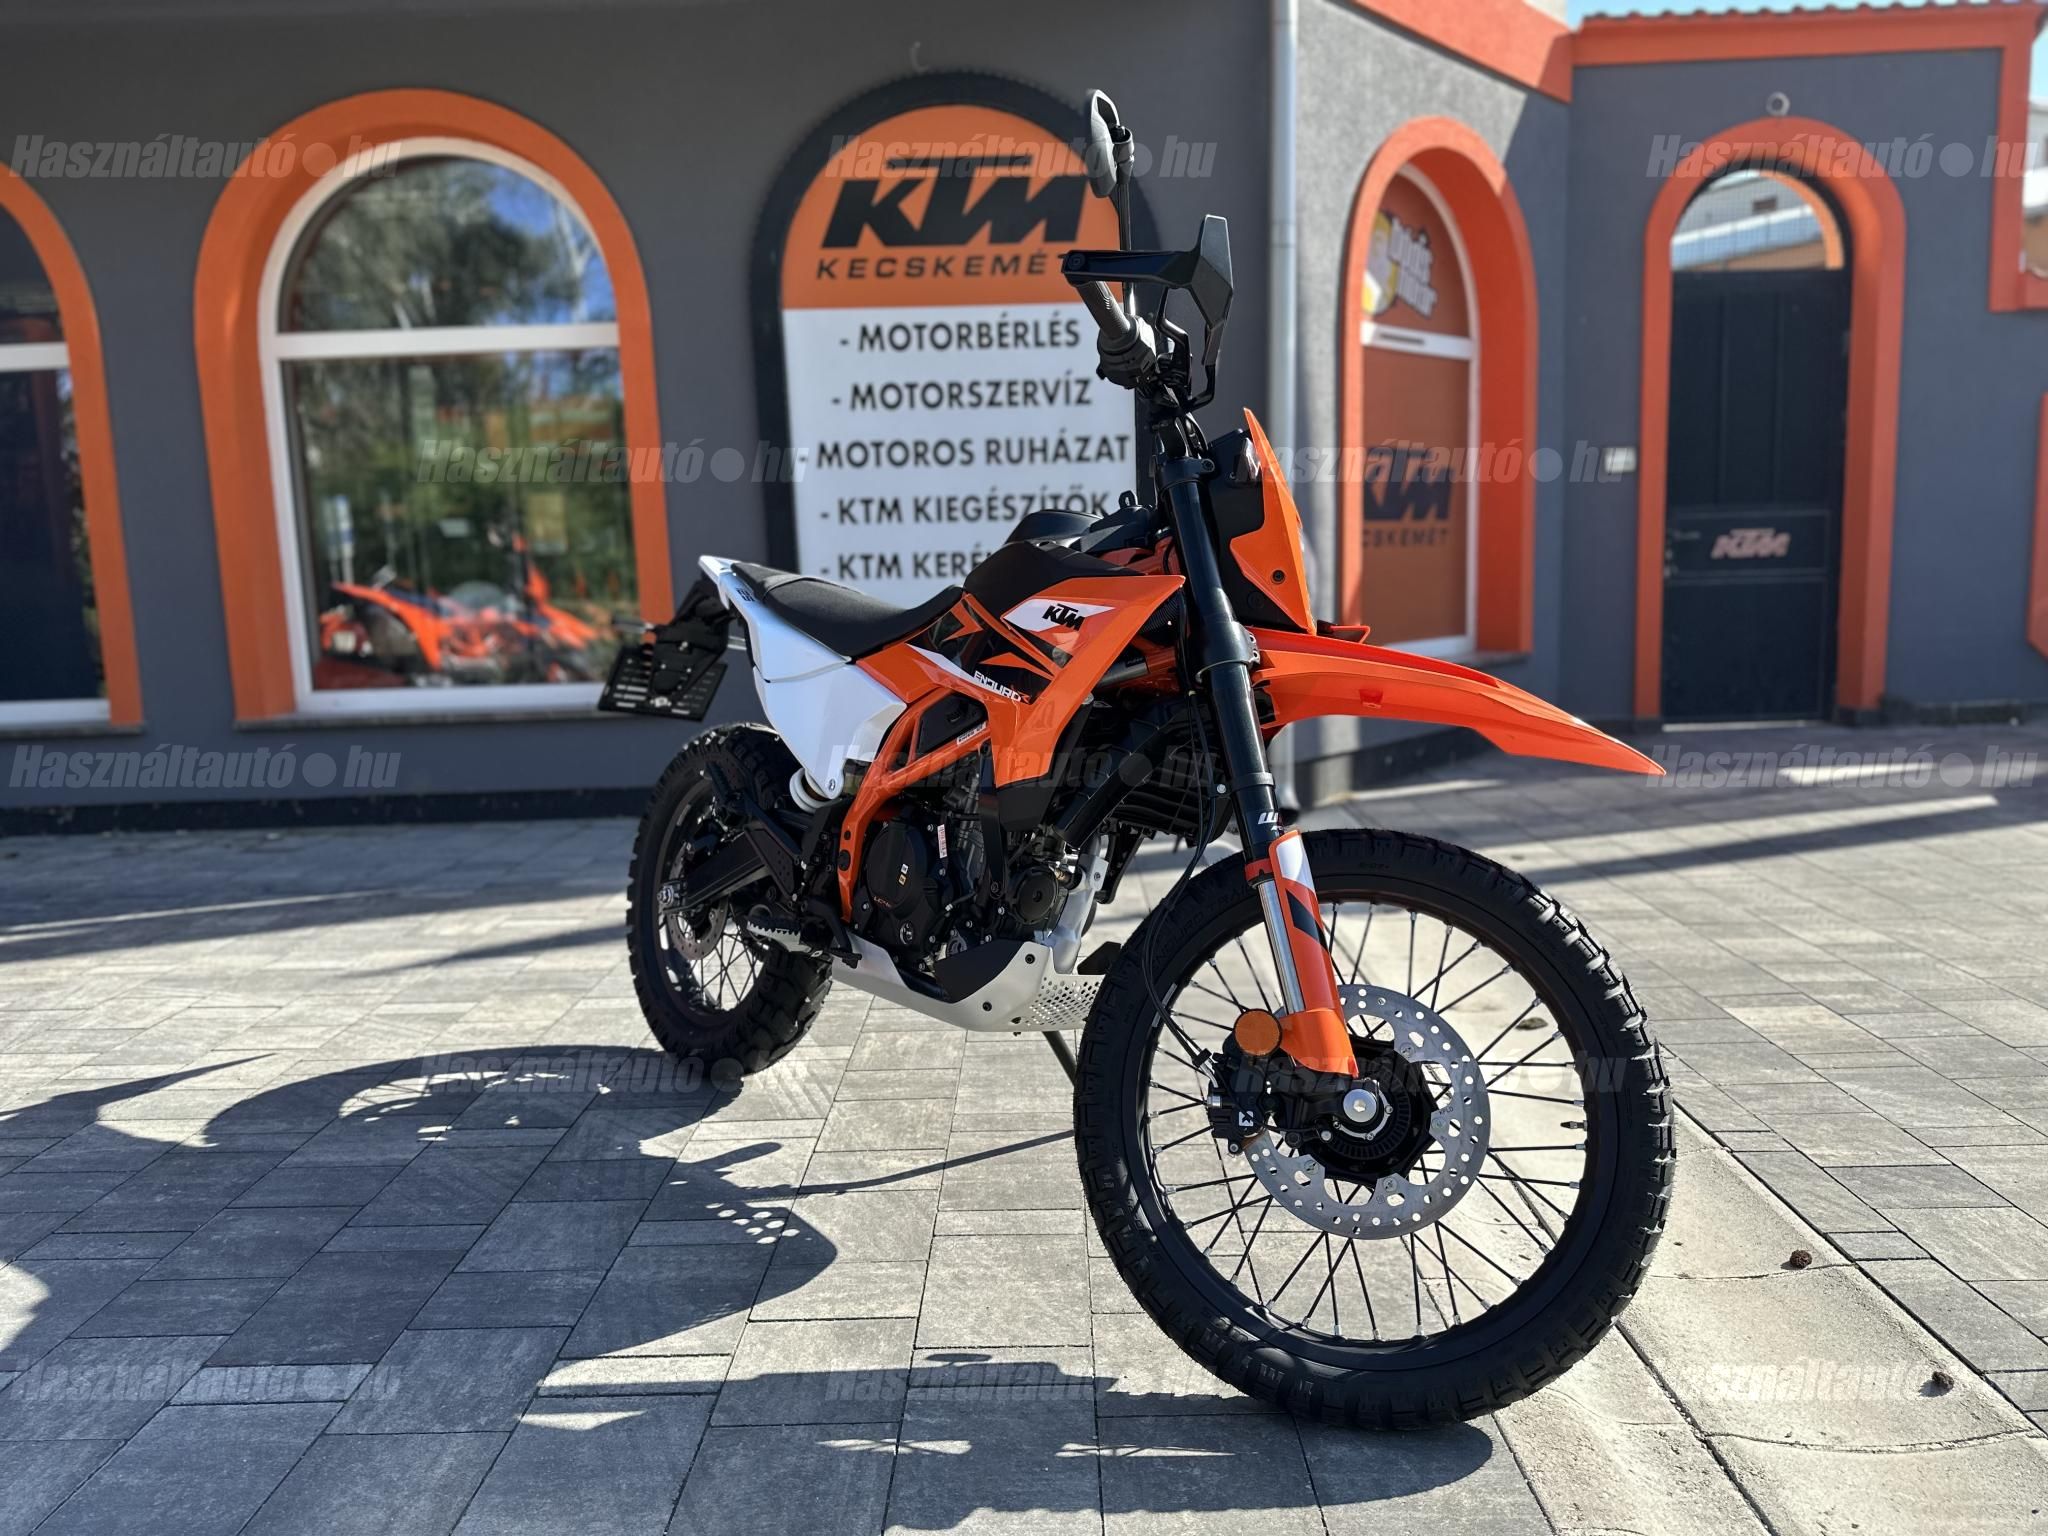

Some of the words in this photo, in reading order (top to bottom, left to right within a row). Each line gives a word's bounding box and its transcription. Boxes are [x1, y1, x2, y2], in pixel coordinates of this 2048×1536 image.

[821, 155, 1091, 249] KTM
[816, 249, 1064, 280] KECSKEMÉ
[858, 312, 1080, 353] MOTORBÉRLÉS
[849, 370, 1092, 411] MOTORSZERVÍZ
[816, 437, 976, 470] MOTOROS
[985, 427, 1131, 466] RUHÁZAT
[837, 496, 904, 525] KTM
[1710, 527, 1791, 559] KTM
[837, 552, 903, 581] KTM
[912, 542, 992, 579] KERÉ
[1042, 603, 1085, 631] KTM
[974, 670, 1022, 702] ENDURO
